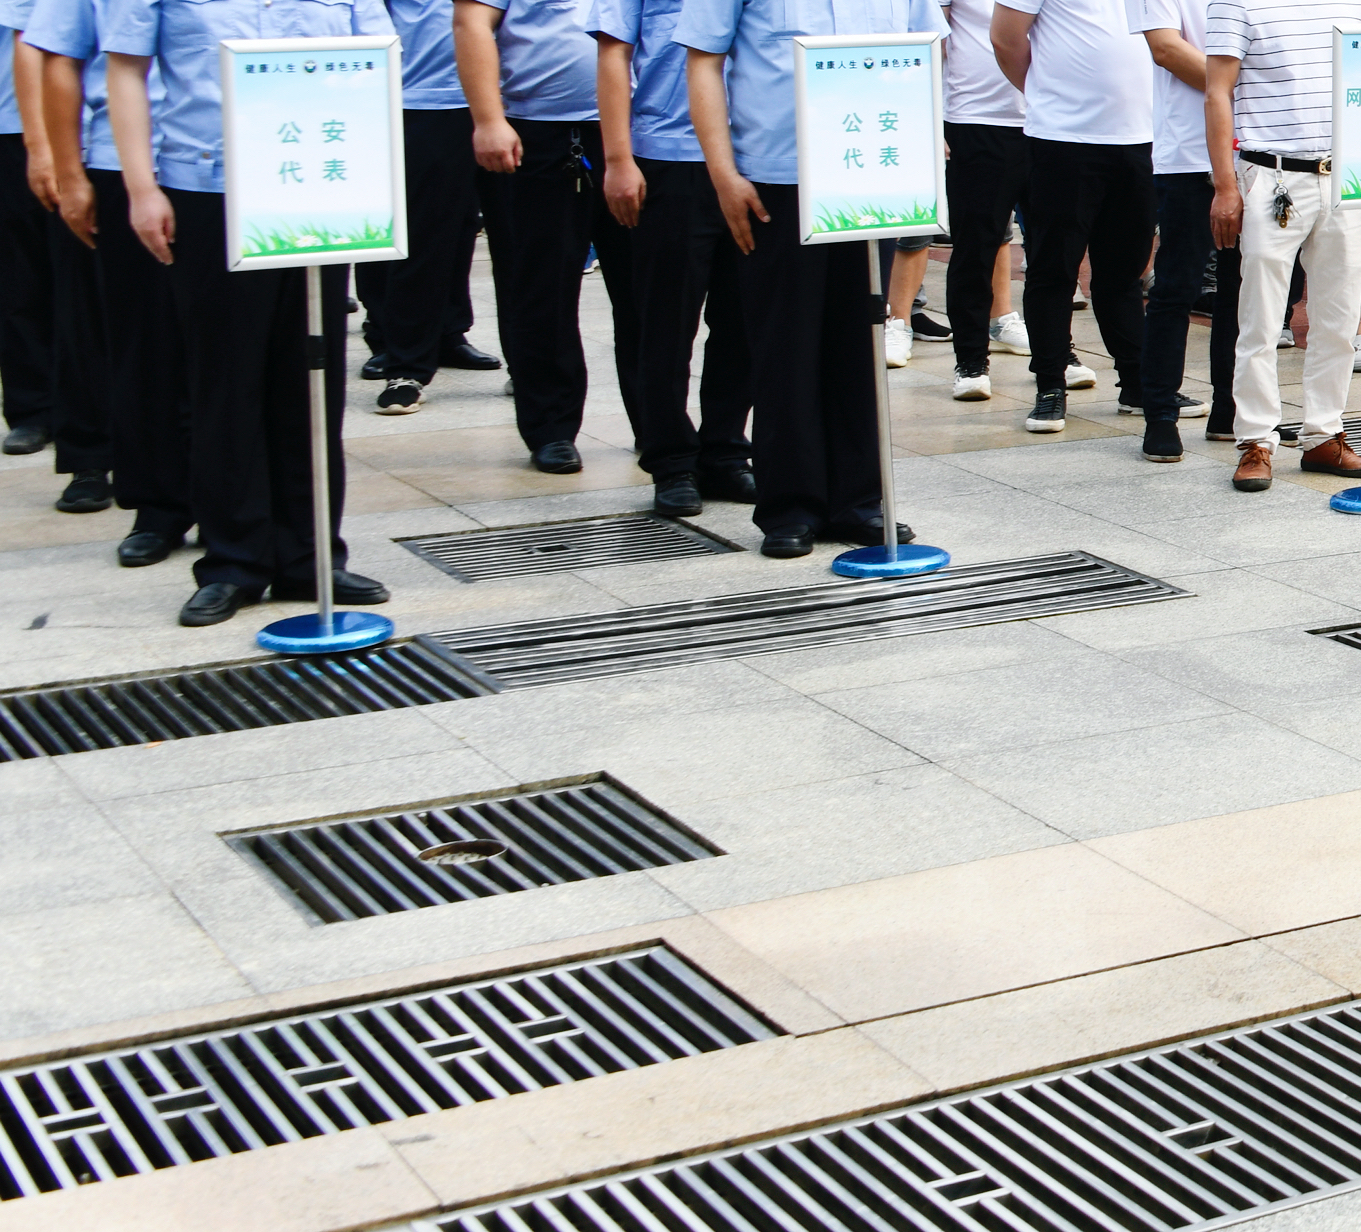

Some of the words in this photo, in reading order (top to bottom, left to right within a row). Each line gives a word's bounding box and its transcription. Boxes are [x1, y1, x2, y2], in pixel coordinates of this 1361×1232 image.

[815, 60, 858, 71] 健康人生
[880, 58, 922, 69] 绿色无毒
[277, 119, 347, 145] 公安
[842, 110, 899, 134] 公安
[843, 145, 900, 170] 代表
[278, 158, 348, 185] 代表
